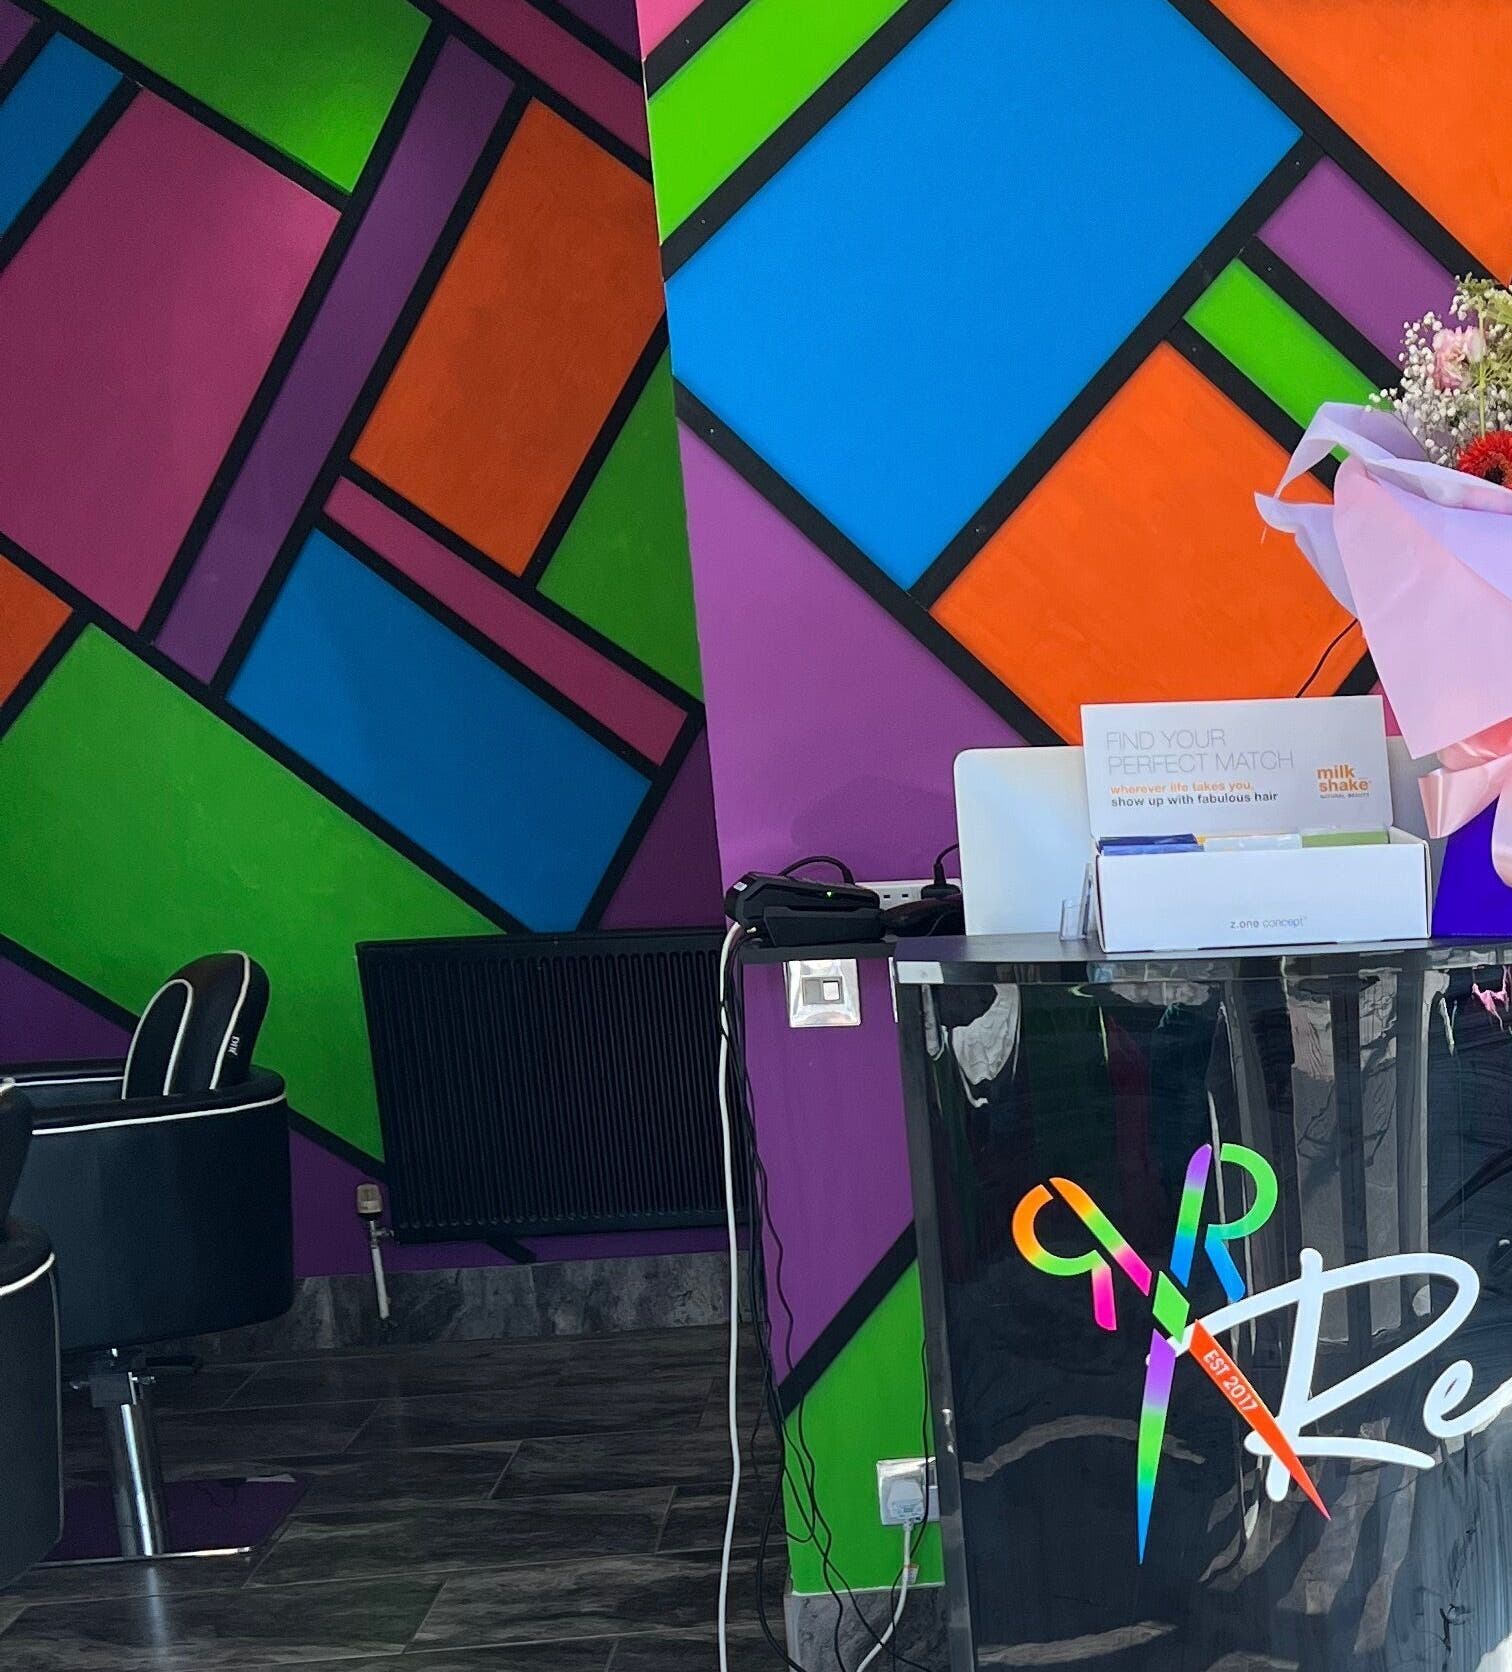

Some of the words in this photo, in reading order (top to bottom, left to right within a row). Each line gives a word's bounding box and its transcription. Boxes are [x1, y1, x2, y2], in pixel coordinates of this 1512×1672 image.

[1106, 731, 1155, 750] FIND
[1160, 728, 1226, 749] YOUR
[1107, 753, 1208, 776] PERFECT
[1215, 750, 1294, 771] MATCH
[1316, 763, 1355, 779] milk
[1110, 782, 1166, 795] wherever
[1170, 781, 1189, 793] life
[1192, 780, 1226, 792] takes
[1319, 778, 1369, 792] shake
[1111, 795, 1145, 808] show
[1148, 797, 1164, 808] up
[1168, 793, 1195, 805] with
[1197, 791, 1251, 804] fabulous
[1254, 790, 1279, 803] hair
[1229, 919, 1260, 929] z.one
[1203, 1349, 1230, 1376] EST
[1222, 1375, 1259, 1411] 2017
